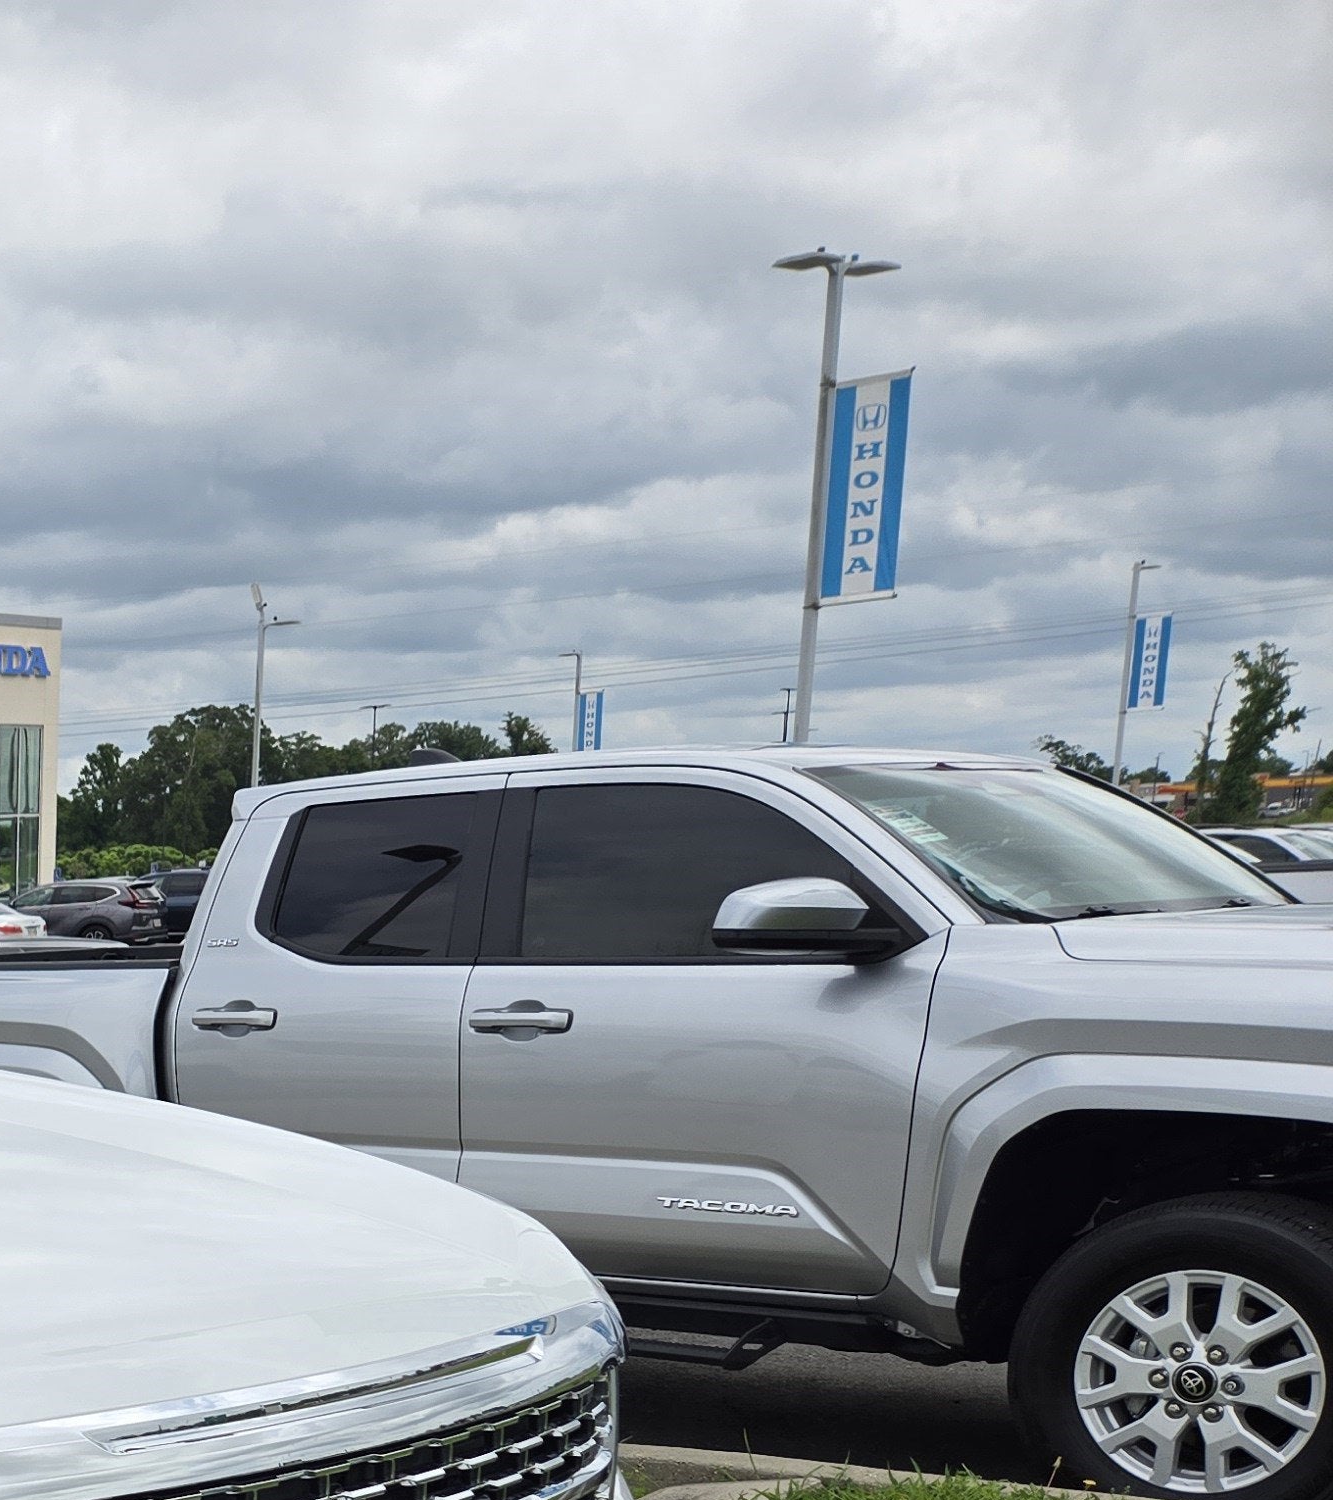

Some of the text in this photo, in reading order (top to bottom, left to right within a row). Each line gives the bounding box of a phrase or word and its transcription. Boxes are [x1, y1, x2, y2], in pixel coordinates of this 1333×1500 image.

[844, 440, 883, 575] HONDA
[1139, 641, 1158, 700] HONDA
[656, 1196, 799, 1218] TACOMA
